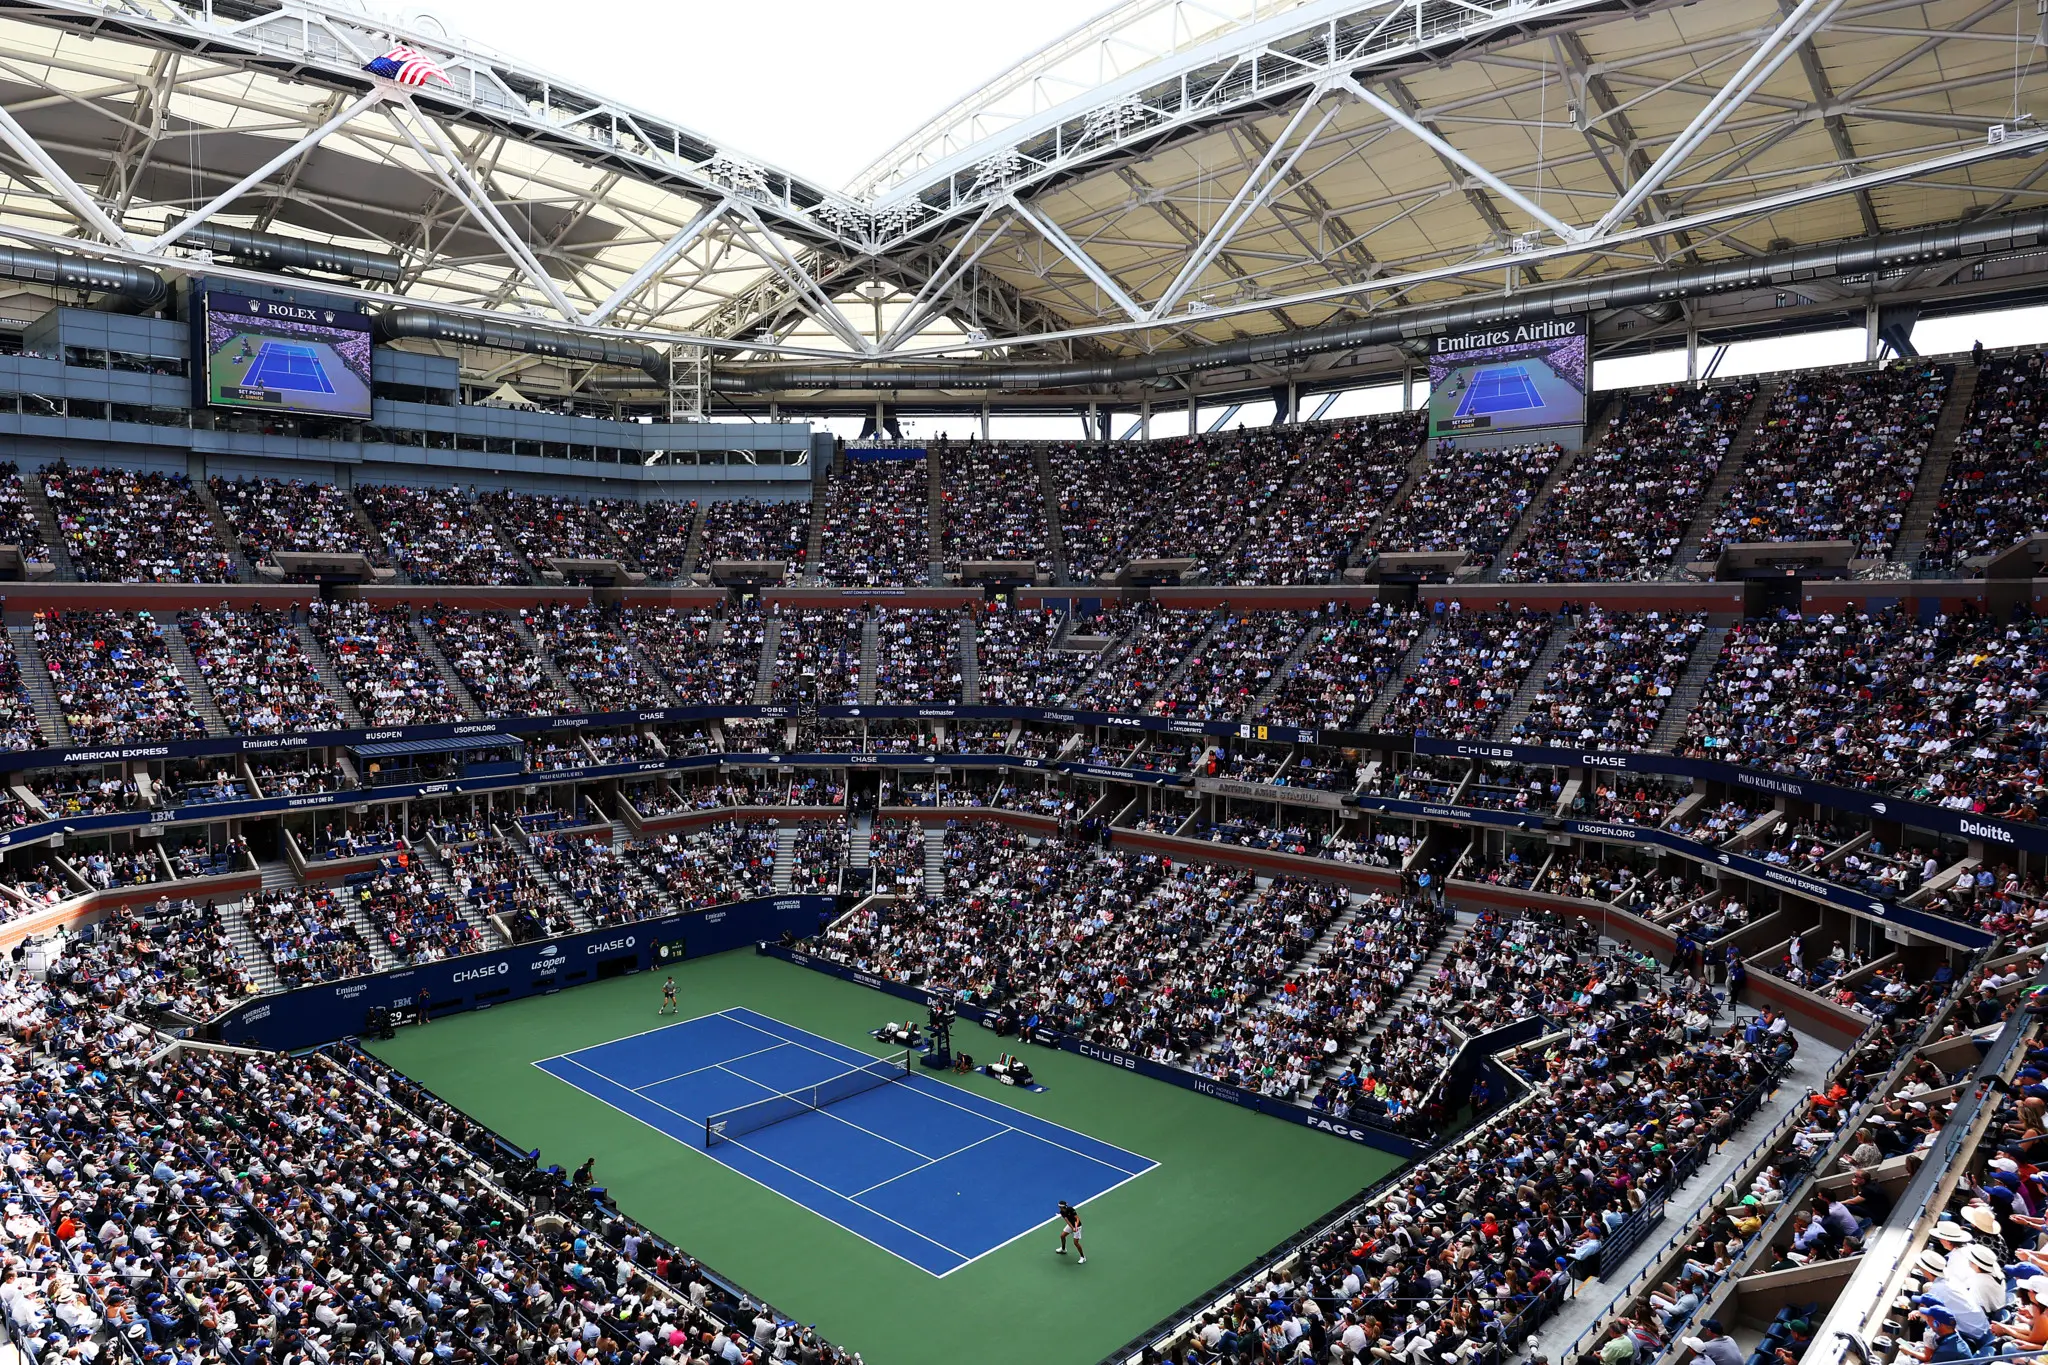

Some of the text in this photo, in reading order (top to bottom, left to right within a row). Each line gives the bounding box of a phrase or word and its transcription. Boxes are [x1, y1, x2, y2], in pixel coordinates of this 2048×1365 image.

[268, 303, 317, 320] ROLEX
[1437, 321, 1576, 352] Emirates Airline
[640, 712, 664, 720] CHASE
[1043, 712, 1074, 722] J.P.Morgan
[1108, 718, 1141, 726] FAGE
[454, 724, 496, 734] USOPEN.ORG
[552, 718, 588, 728] J.P.Morgan
[366, 731, 402, 740] #USOPEN
[1298, 735, 1314, 743] IBM
[242, 736, 308, 748] Emirates Airline
[64, 747, 168, 762] AMERICAN EXPRESS
[1457, 746, 1514, 757] CHUBB
[1582, 755, 1626, 767] CHASE
[426, 784, 448, 792] ESPN
[1738, 774, 1802, 796] POLO RALPH LAUREN
[1219, 784, 1319, 802] ARTHUR ASHE STADIUM
[150, 810, 175, 822] IBM
[1423, 806, 1471, 818] Emirates Airline
[1577, 824, 1636, 839] USOPEN.ORG
[1960, 819, 2014, 843] Deloitte.
[1765, 870, 1828, 896] AMERICAN EXPRESS
[705, 912, 726, 920] Emirates
[587, 939, 624, 954] CHASE
[531, 956, 566, 970] us open
[453, 966, 496, 982] CHASE
[540, 967, 557, 976] finals
[336, 984, 367, 996] Emirates
[393, 997, 412, 1008] IBM
[242, 1004, 270, 1020] AMERICAN
[245, 1010, 271, 1024] EXPRESS
[1079, 1044, 1136, 1069] CHUBB
[1194, 1080, 1214, 1094] IHG
[1216, 1086, 1235, 1096] HOTELS
[1216, 1092, 1238, 1102] RESORTS
[1307, 1116, 1364, 1140] FAGE
